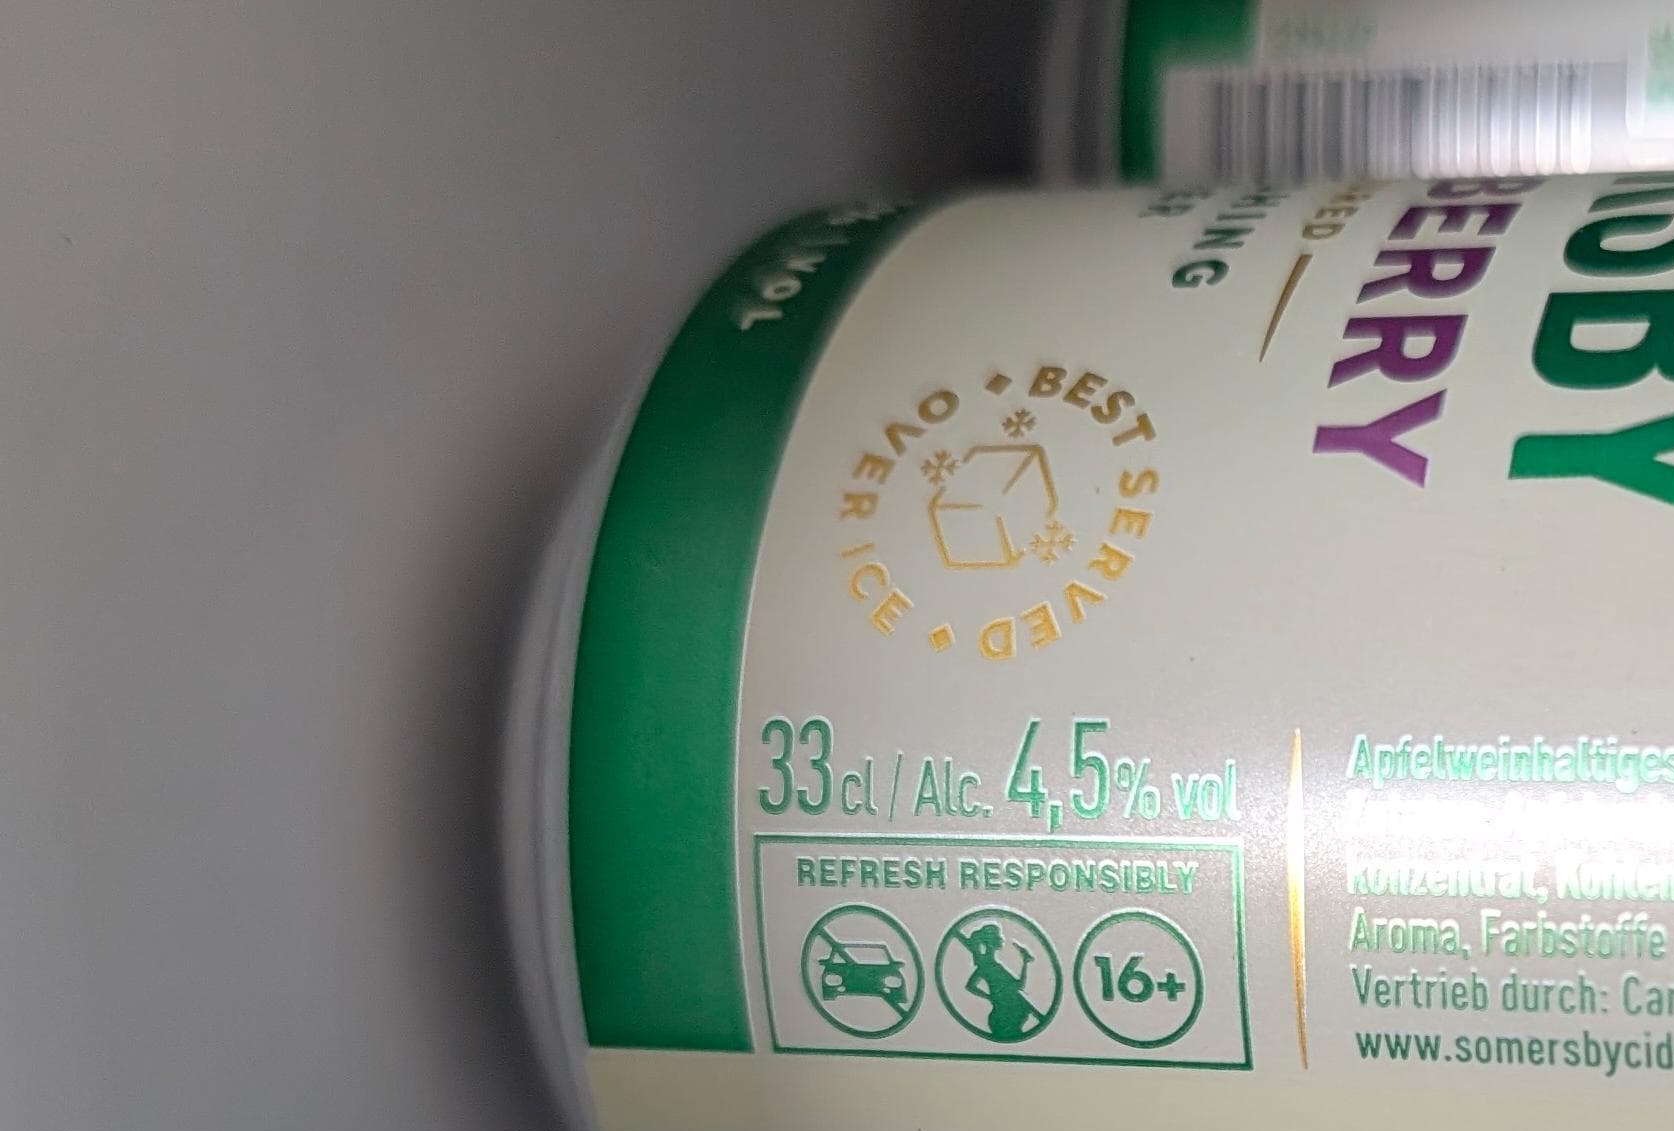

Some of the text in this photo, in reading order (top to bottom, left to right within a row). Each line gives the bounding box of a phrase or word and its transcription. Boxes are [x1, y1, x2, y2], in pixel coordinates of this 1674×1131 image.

[839, 389, 960, 636] OVER ICE
[977, 366, 1160, 661] BEST SERVED
[913, 755, 994, 819] Alc.
[1004, 716, 1161, 833] 4,5%
[1171, 760, 1242, 822] vol
[797, 855, 1199, 895] REFRESH RESPONSIBLY
[1346, 906, 1471, 961] Aroma,
[1480, 909, 1668, 960] Farbstoffe
[1093, 953, 1187, 1003] 16+
[1349, 964, 1489, 1012] Vertrieb
[1500, 967, 1609, 1016] durch:
